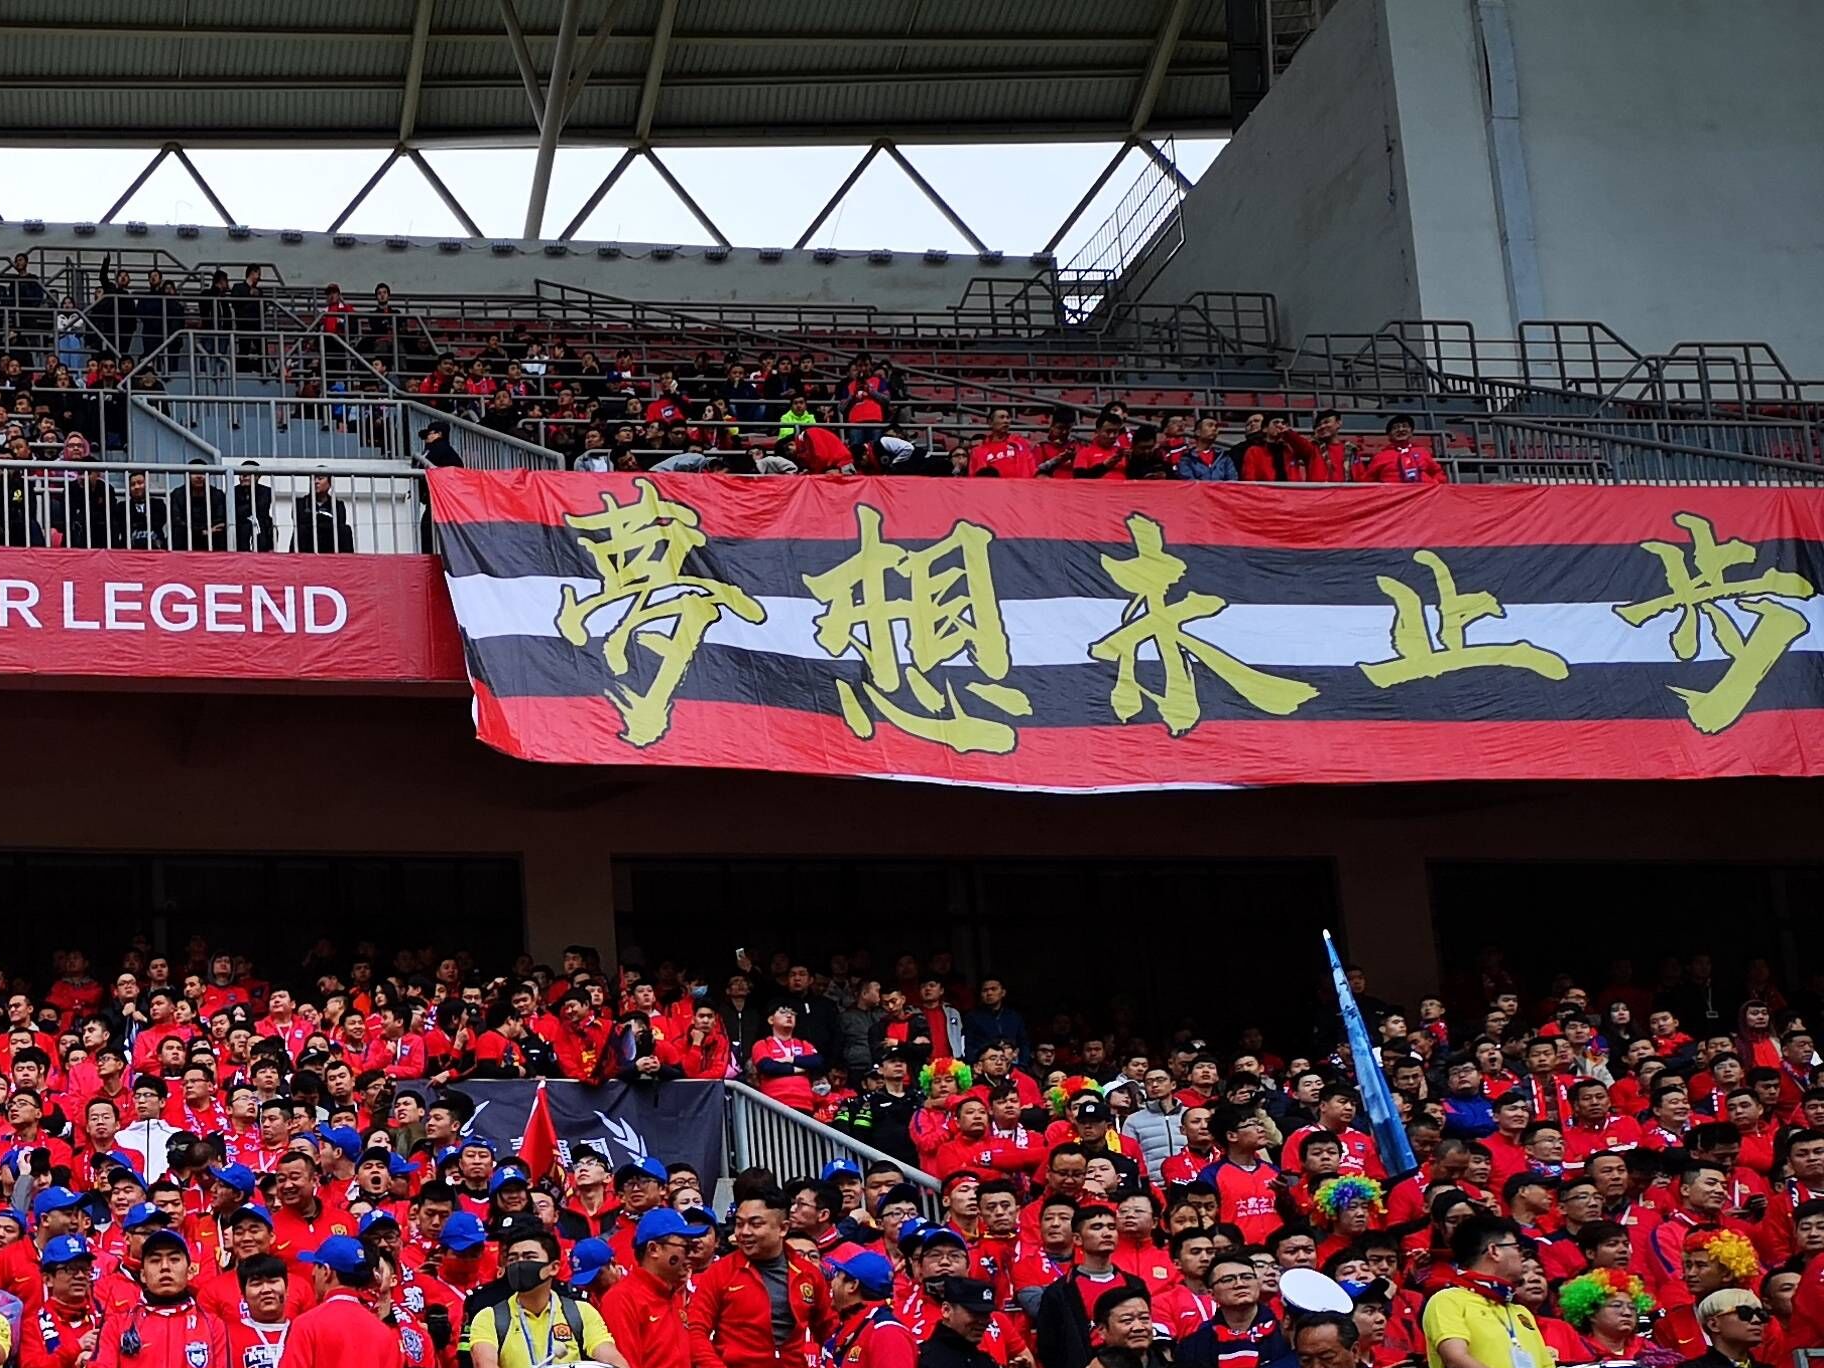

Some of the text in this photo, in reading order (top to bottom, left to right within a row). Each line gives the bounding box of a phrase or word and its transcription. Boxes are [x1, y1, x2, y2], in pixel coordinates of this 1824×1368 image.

[63, 581, 348, 634] LEGEND
[555, 477, 1822, 755] 夢想未止步
